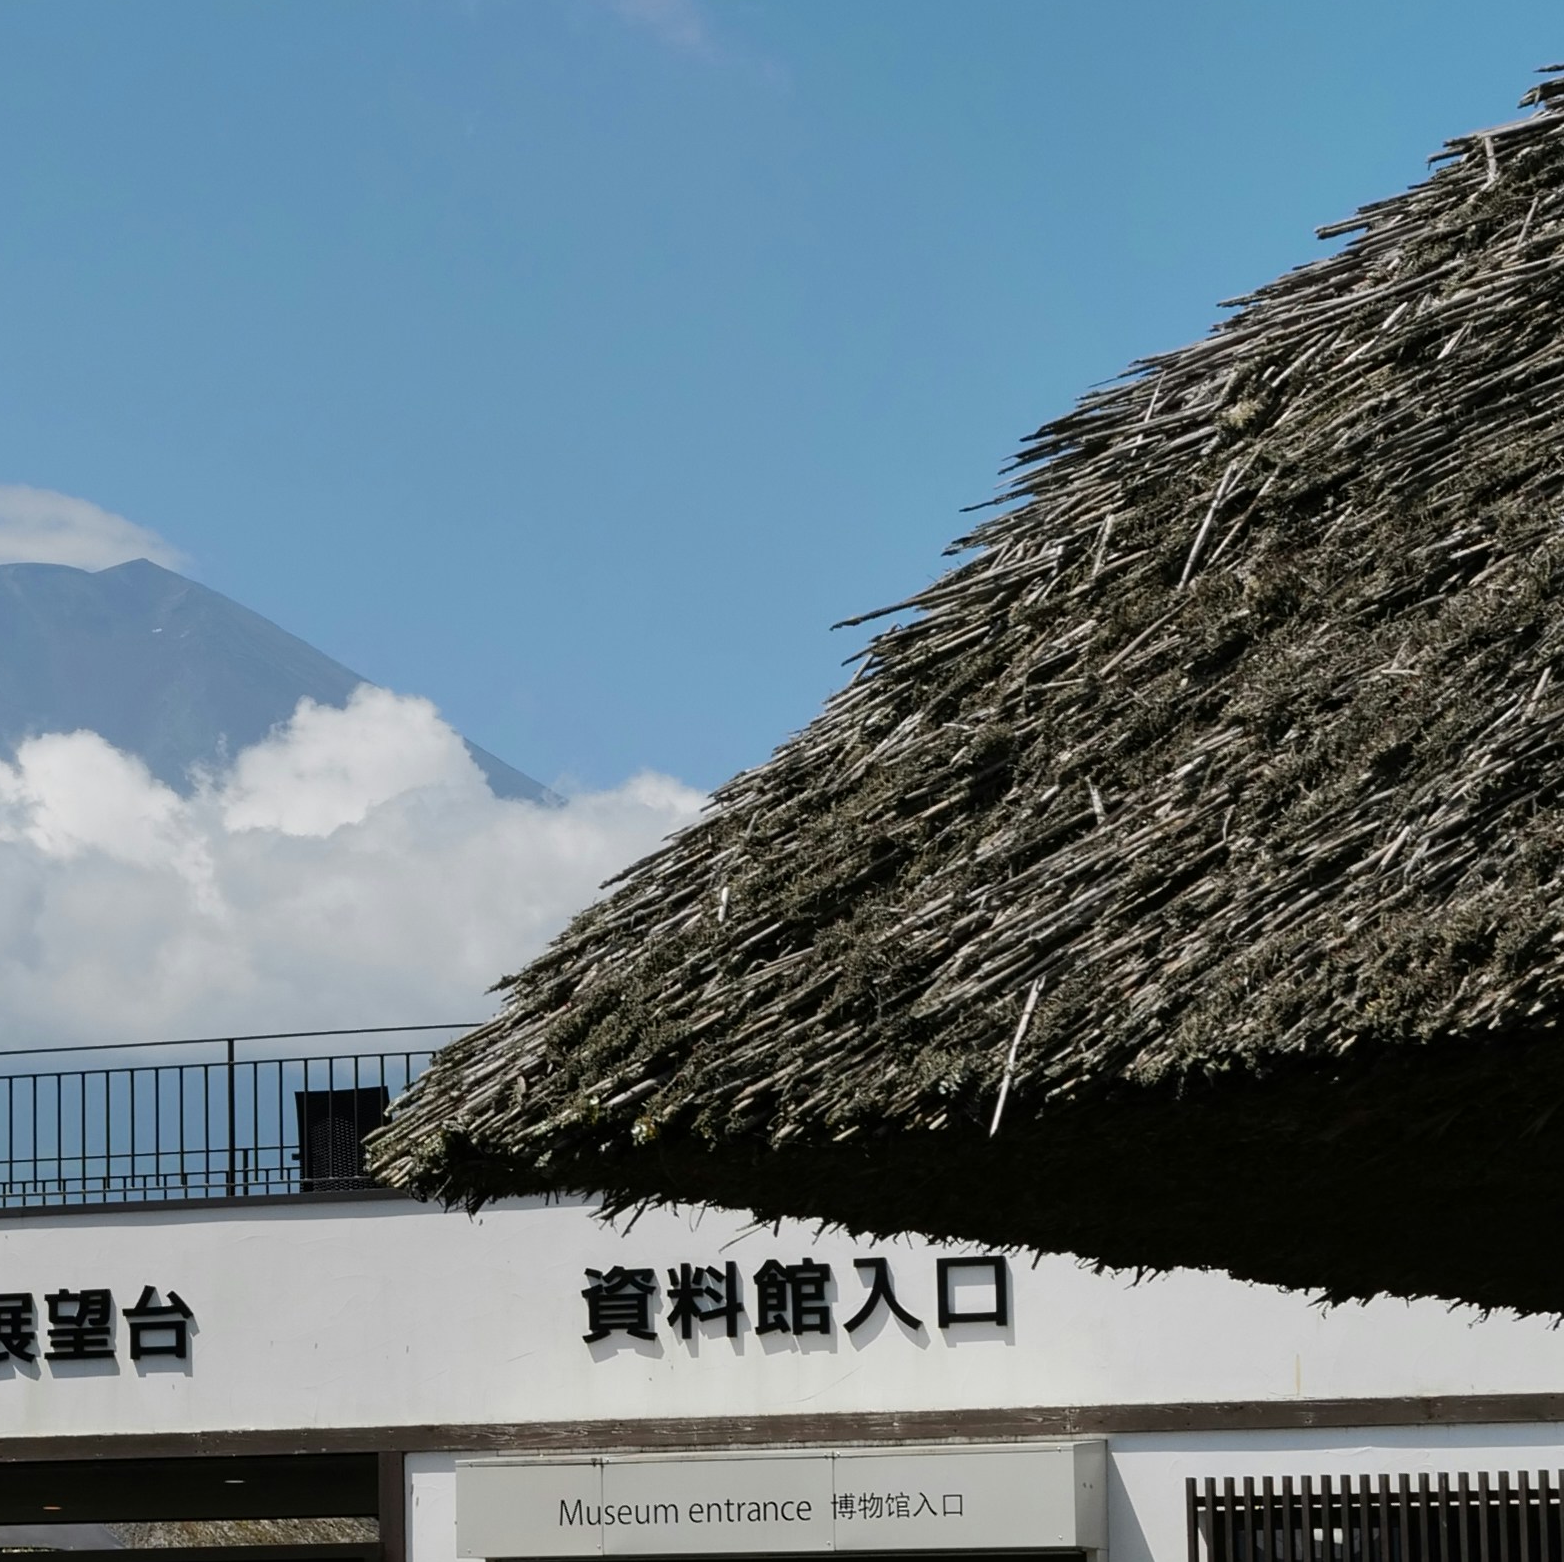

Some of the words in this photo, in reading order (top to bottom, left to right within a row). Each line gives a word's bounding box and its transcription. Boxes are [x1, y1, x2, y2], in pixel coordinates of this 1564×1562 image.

[581, 1255, 1009, 1344] 資料館入口
[558, 1498, 679, 1528] Museum
[688, 1496, 812, 1525] entrance
[831, 1492, 965, 1521] 博物馆入口
